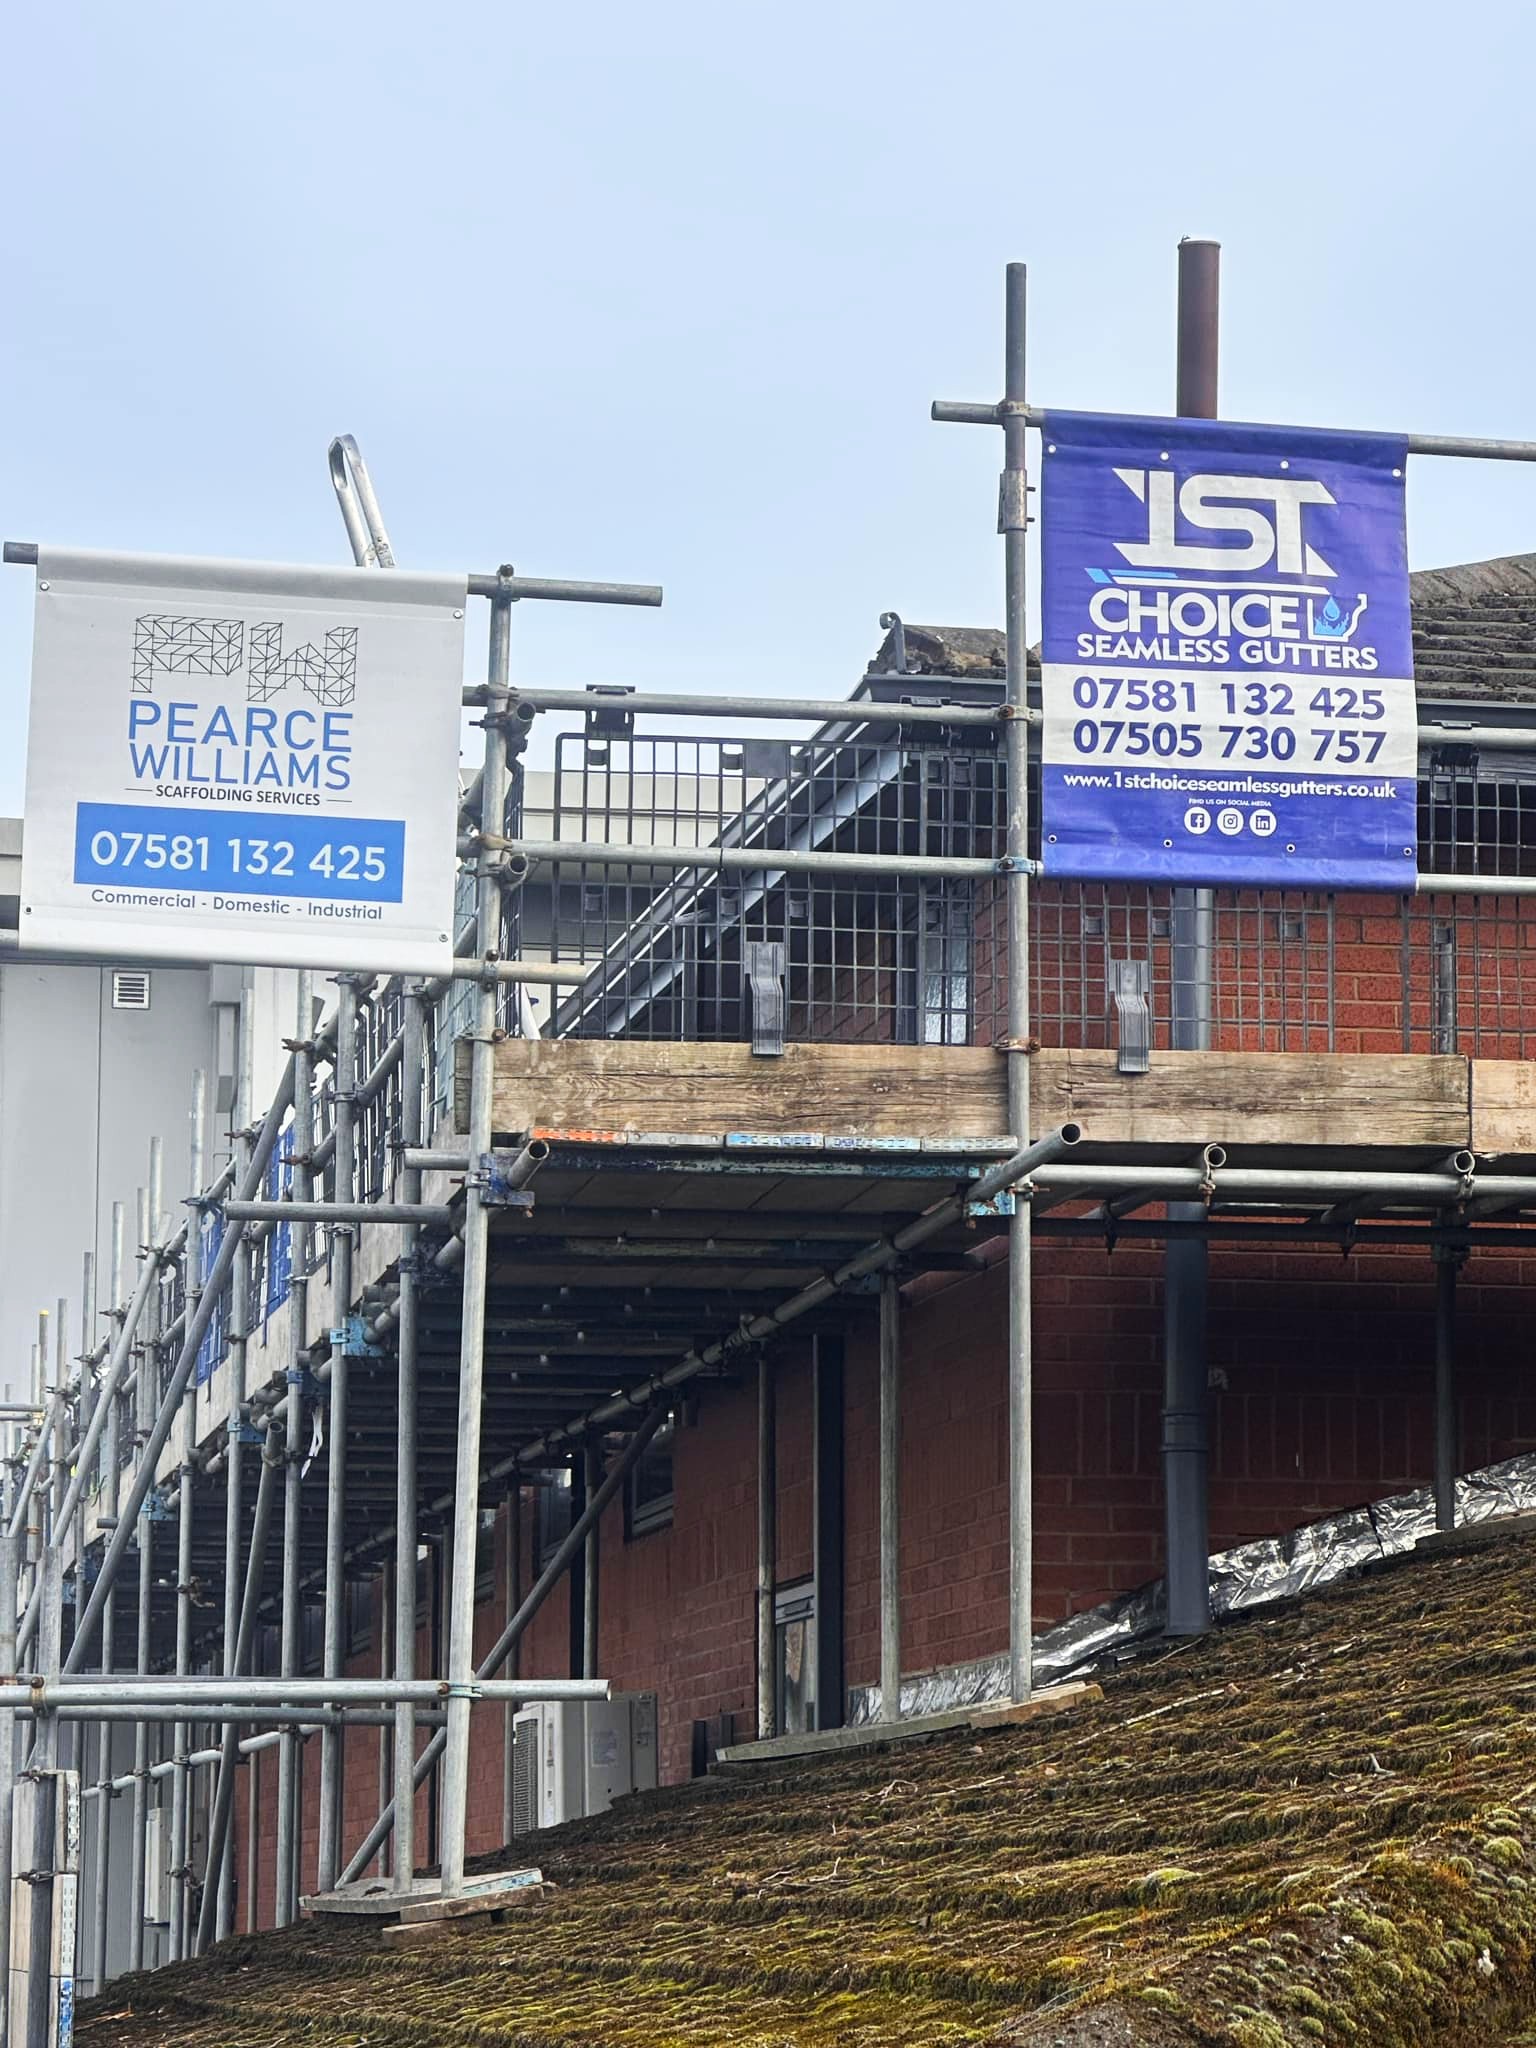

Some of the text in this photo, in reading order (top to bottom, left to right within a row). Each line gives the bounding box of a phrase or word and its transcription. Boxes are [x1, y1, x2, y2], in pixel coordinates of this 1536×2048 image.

[1088, 587, 1301, 640] CHOICE
[129, 613, 359, 707] PW
[1077, 633, 1378, 670] SEAMLESS GUTTERS
[1072, 676, 1386, 720] 07581 132 425
[128, 700, 353, 753] PEARCE
[1072, 719, 1387, 764] 07505 730 757
[129, 743, 351, 791] WILLIAMS
[1063, 771, 1396, 800] www.1stchoiceseamlessgutters.co.uk
[155, 784, 321, 806] SCAFFOLDING SERVICES
[90, 830, 386, 881] 07581 132 425
[91, 889, 196, 909] Commercial
[212, 896, 291, 914] Domestic
[307, 902, 383, 920] Industrial
